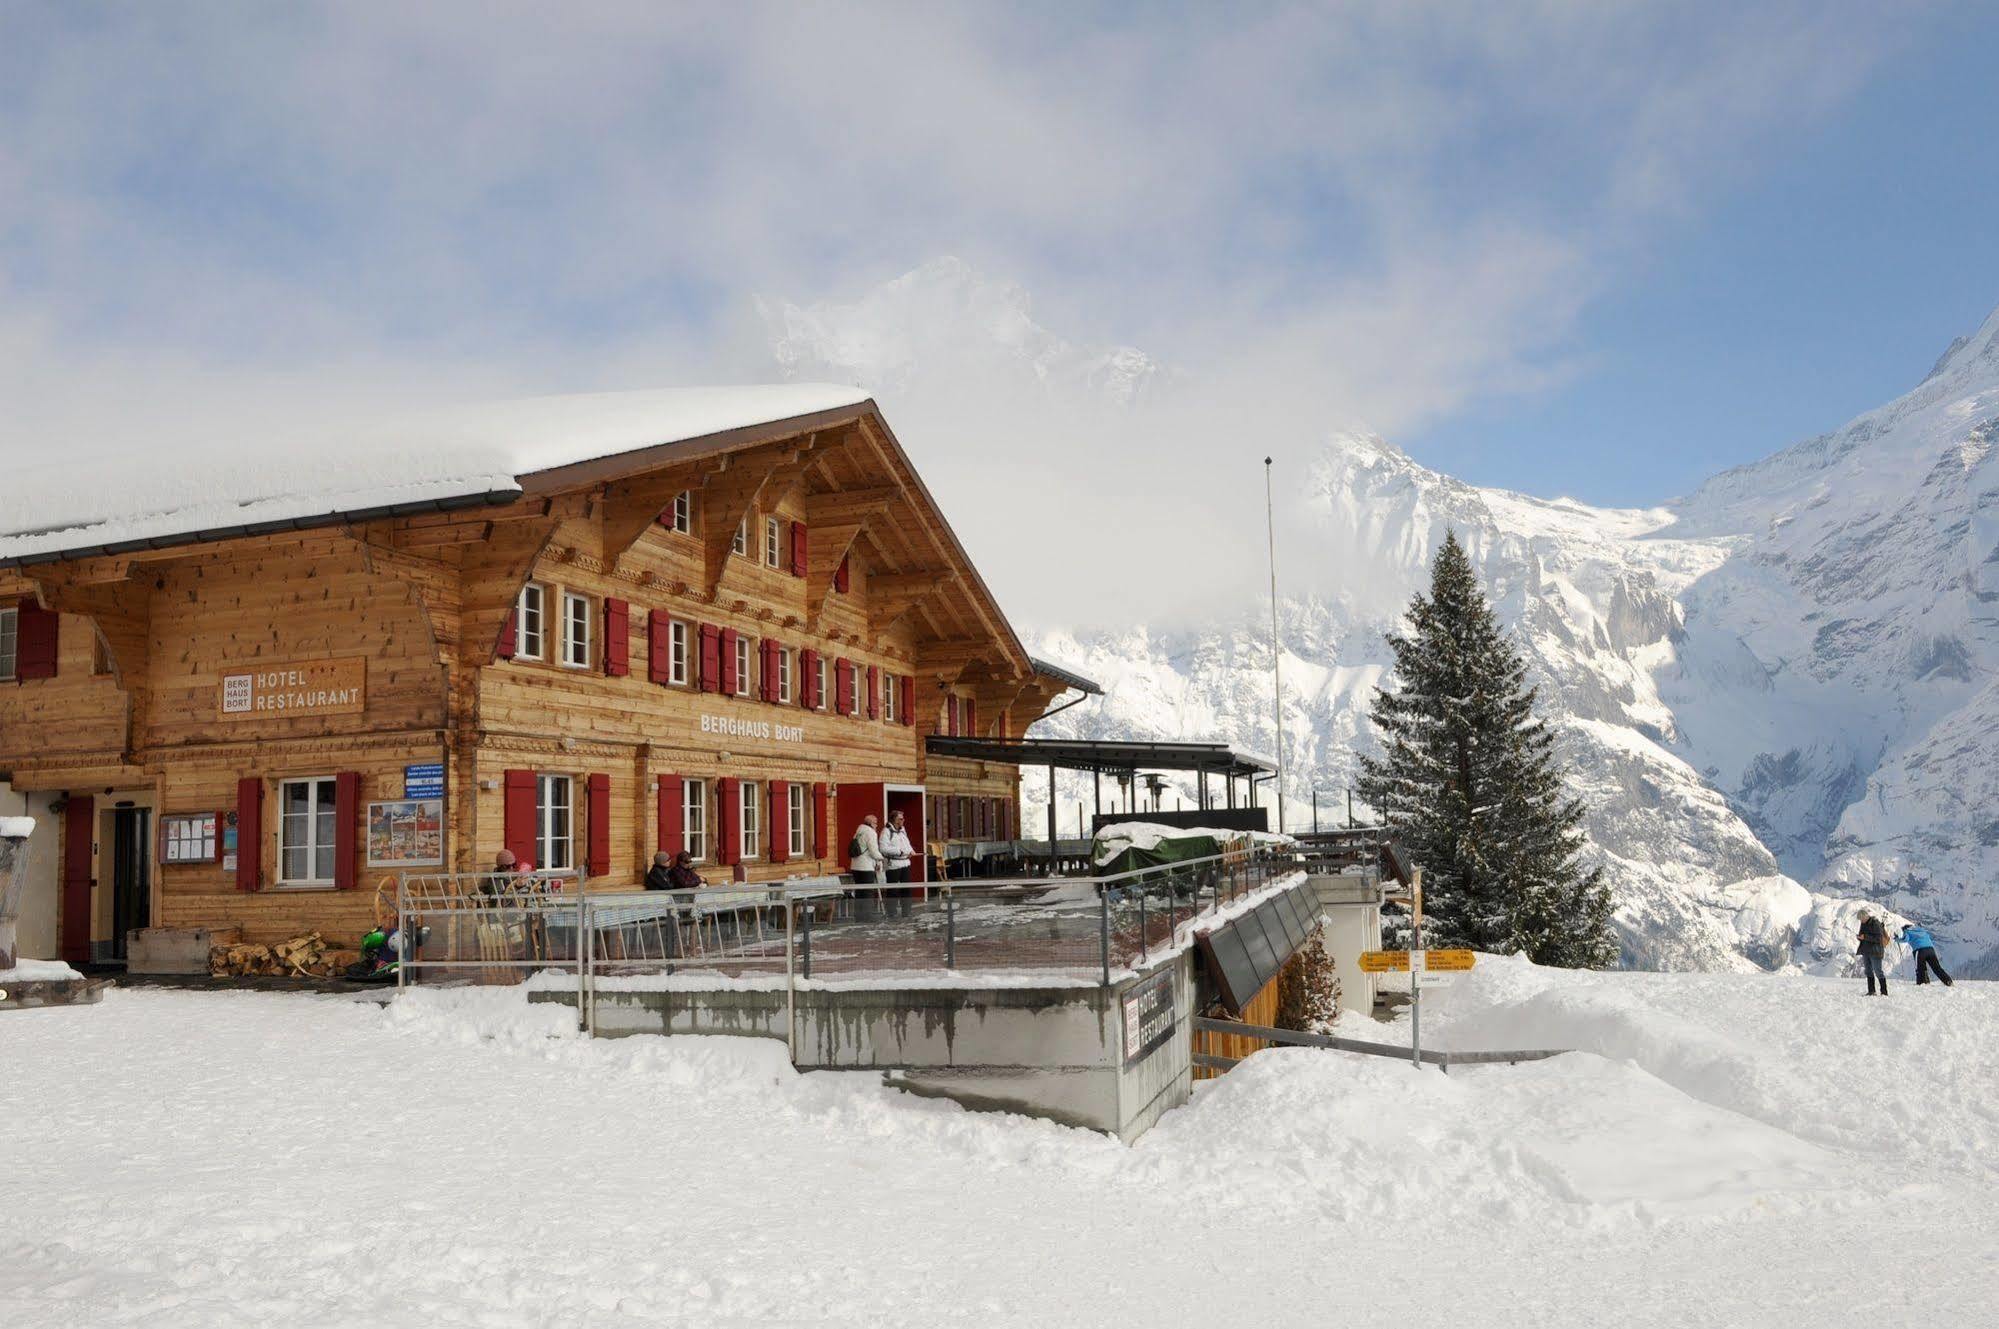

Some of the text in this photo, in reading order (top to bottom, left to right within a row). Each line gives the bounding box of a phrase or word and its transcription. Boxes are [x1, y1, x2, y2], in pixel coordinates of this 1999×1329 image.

[227, 679, 249, 688] BERG
[257, 671, 306, 688] HOTEL
[227, 689, 249, 698] HAUS
[227, 699, 248, 708] BORT
[257, 688, 360, 711] RESTAURANT
[701, 714, 804, 743] BERGHAUS BORT
[1140, 988, 1158, 1017] HOTEL
[1140, 1006, 1174, 1047] RESTAURANT
